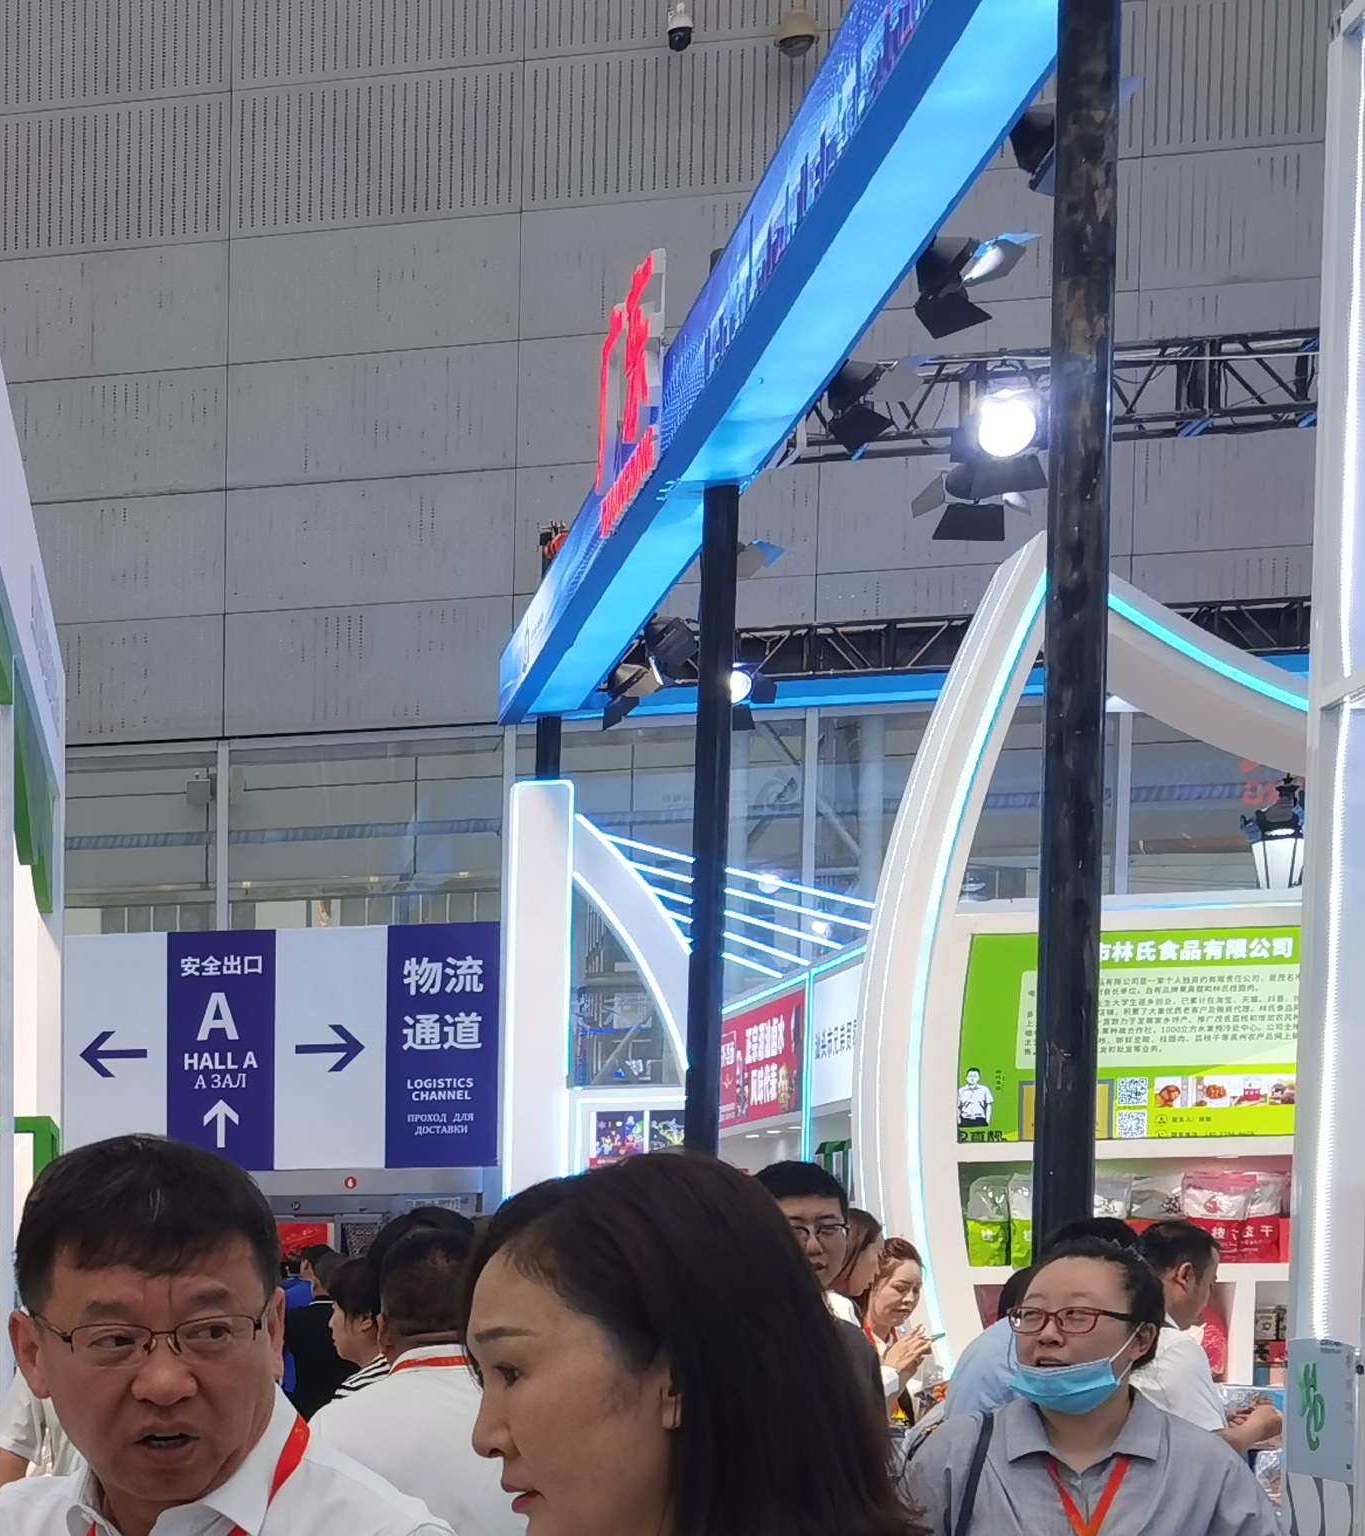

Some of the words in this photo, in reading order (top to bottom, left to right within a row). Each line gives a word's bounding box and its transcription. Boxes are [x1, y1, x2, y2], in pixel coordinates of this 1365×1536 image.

[181, 955, 263, 977] 安全出口
[403, 956, 484, 995] 物流
[196, 992, 240, 1041] A
[402, 1012, 482, 1051] 通道
[184, 1052, 238, 1071] HALL
[242, 1051, 258, 1069] A
[211, 1073, 247, 1089] ЗАЛ
[407, 1077, 474, 1090] LOGISTICS
[412, 1089, 471, 1101] CHANNEL
[407, 1113, 447, 1124] ПРОХОД
[453, 1112, 474, 1123] ДЛЯ
[414, 1125, 468, 1136] ДОСТАВКИ
